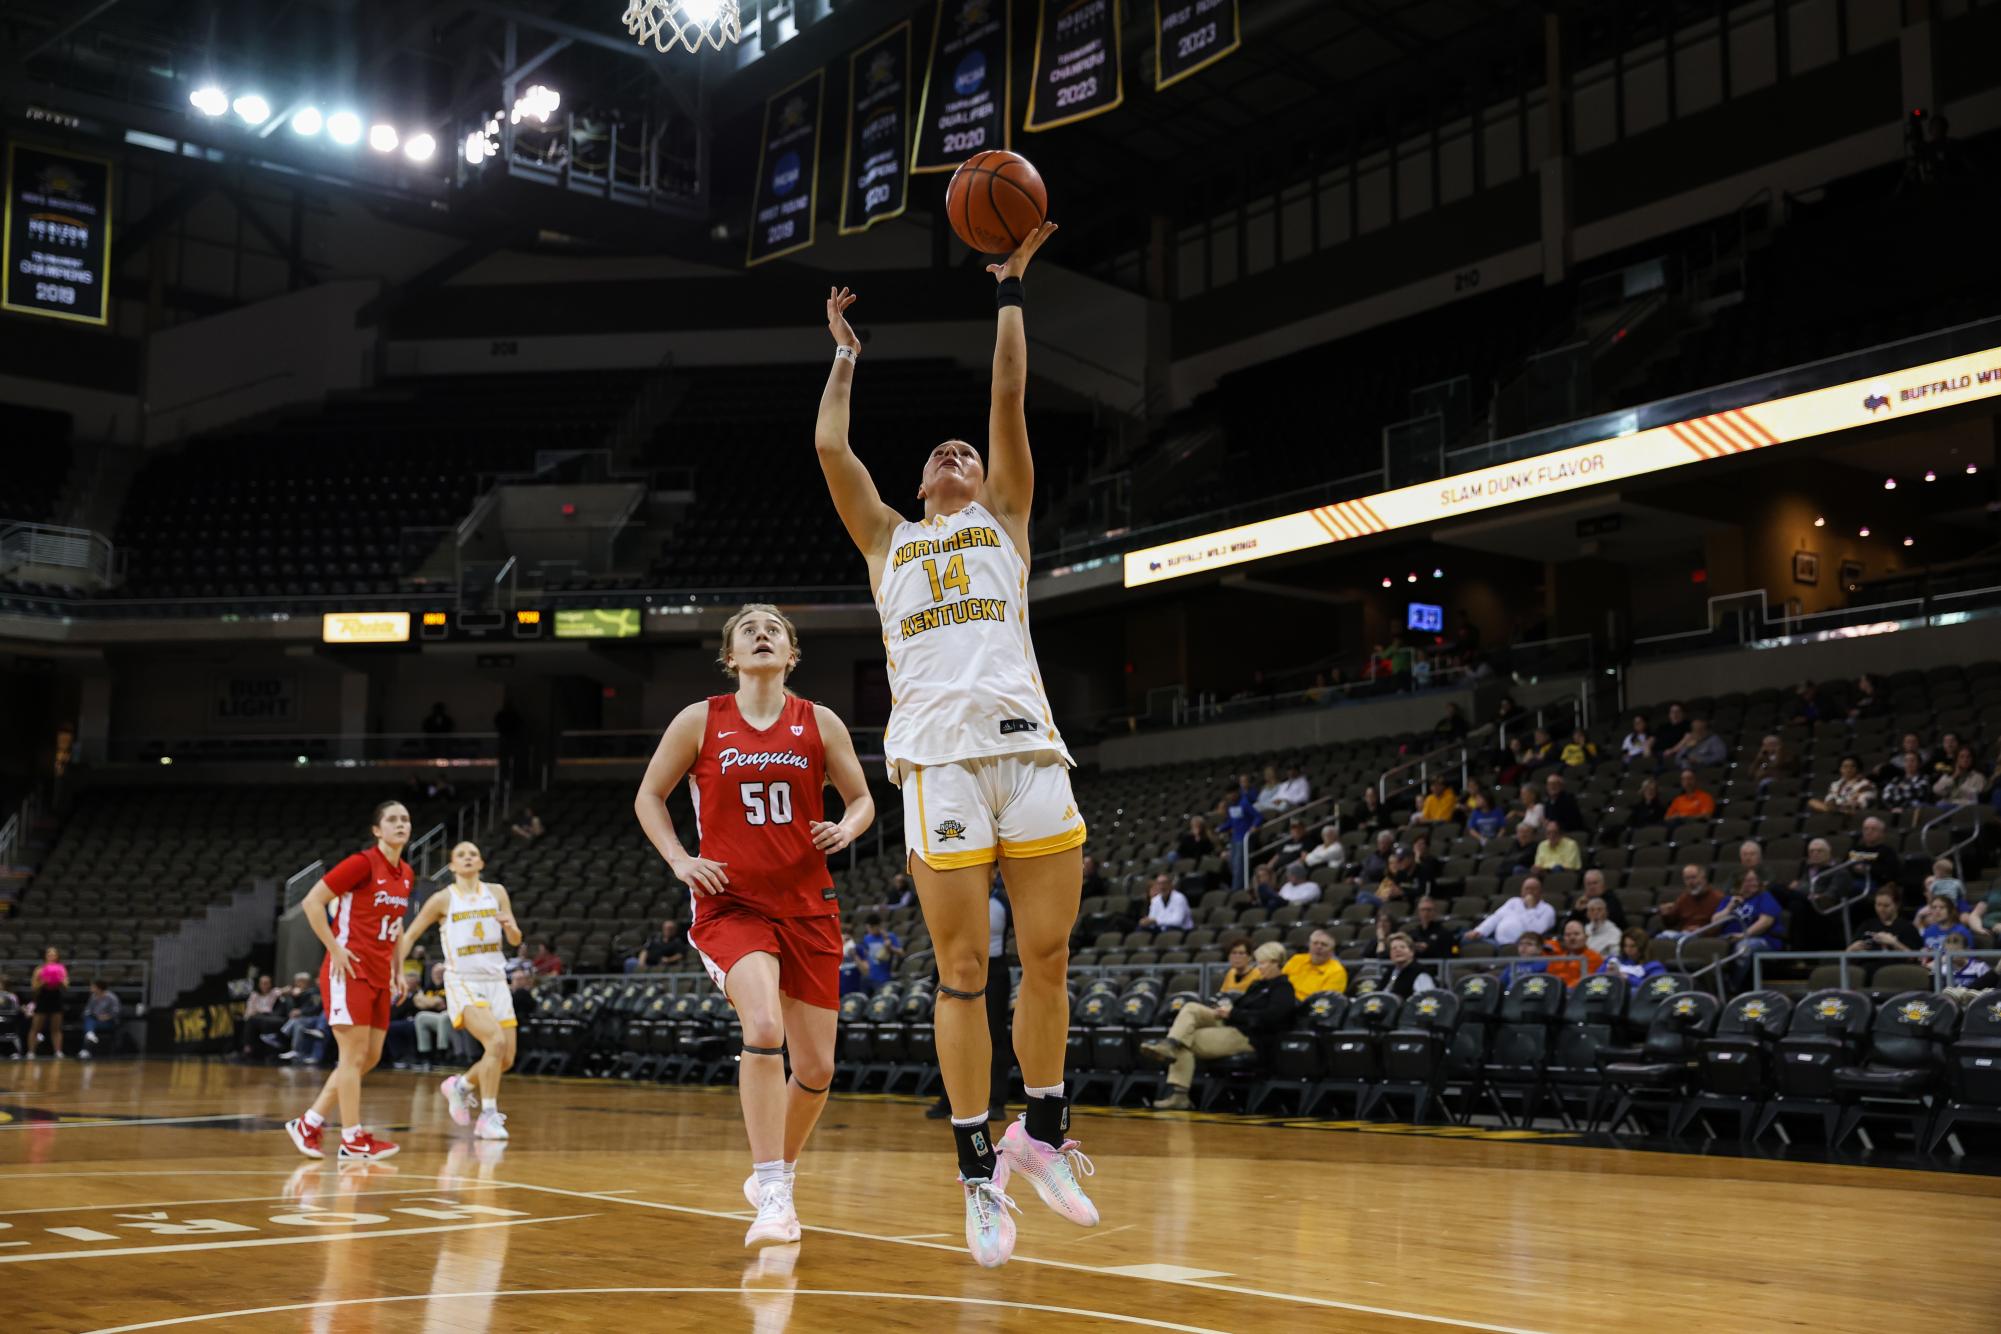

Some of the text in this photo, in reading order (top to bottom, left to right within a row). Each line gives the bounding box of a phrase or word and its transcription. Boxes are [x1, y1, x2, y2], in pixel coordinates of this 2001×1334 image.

[1177, 22, 1216, 58] 2023
[1056, 76, 1098, 107] 2023
[938, 102, 994, 130] QUALIFIER
[943, 126, 986, 154] 2020
[1901, 374, 1971, 402] BUFFALO
[1440, 454, 1605, 506] SLAM DUNK FLAVOR
[893, 526, 1001, 572] NORTHERN
[922, 552, 971, 603] 14
[900, 598, 1006, 641] KENTUCKY
[718, 747, 809, 775] Penguins
[739, 781, 793, 826] 50
[377, 914, 404, 943] 14
[472, 920, 486, 942] 4
